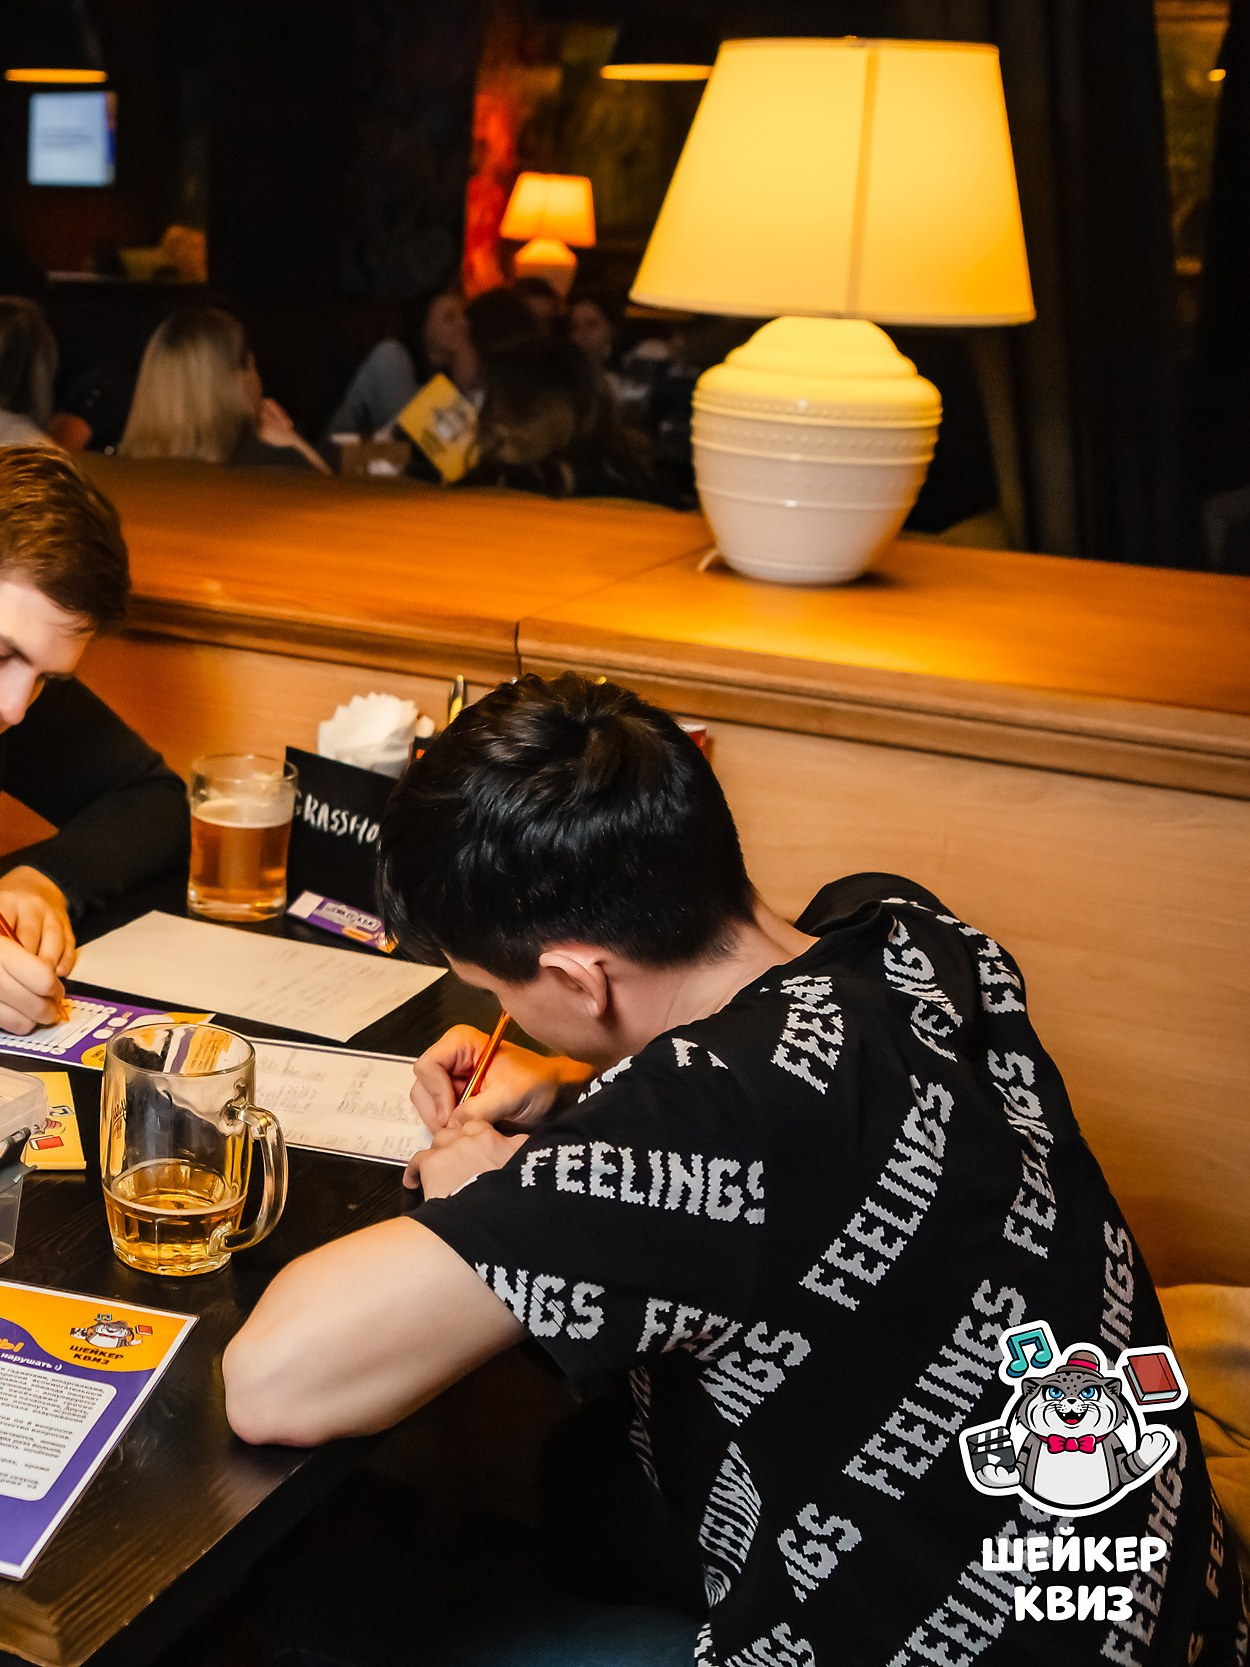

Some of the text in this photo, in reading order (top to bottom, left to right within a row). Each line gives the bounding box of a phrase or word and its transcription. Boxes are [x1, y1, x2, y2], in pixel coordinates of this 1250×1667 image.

[798, 1075, 954, 1312] FEELINGS
[0, 1351, 53, 1371] нарушать
[69, 1344, 124, 1360] ШЕЙКЕР
[72, 1353, 111, 1366] КВИЗ
